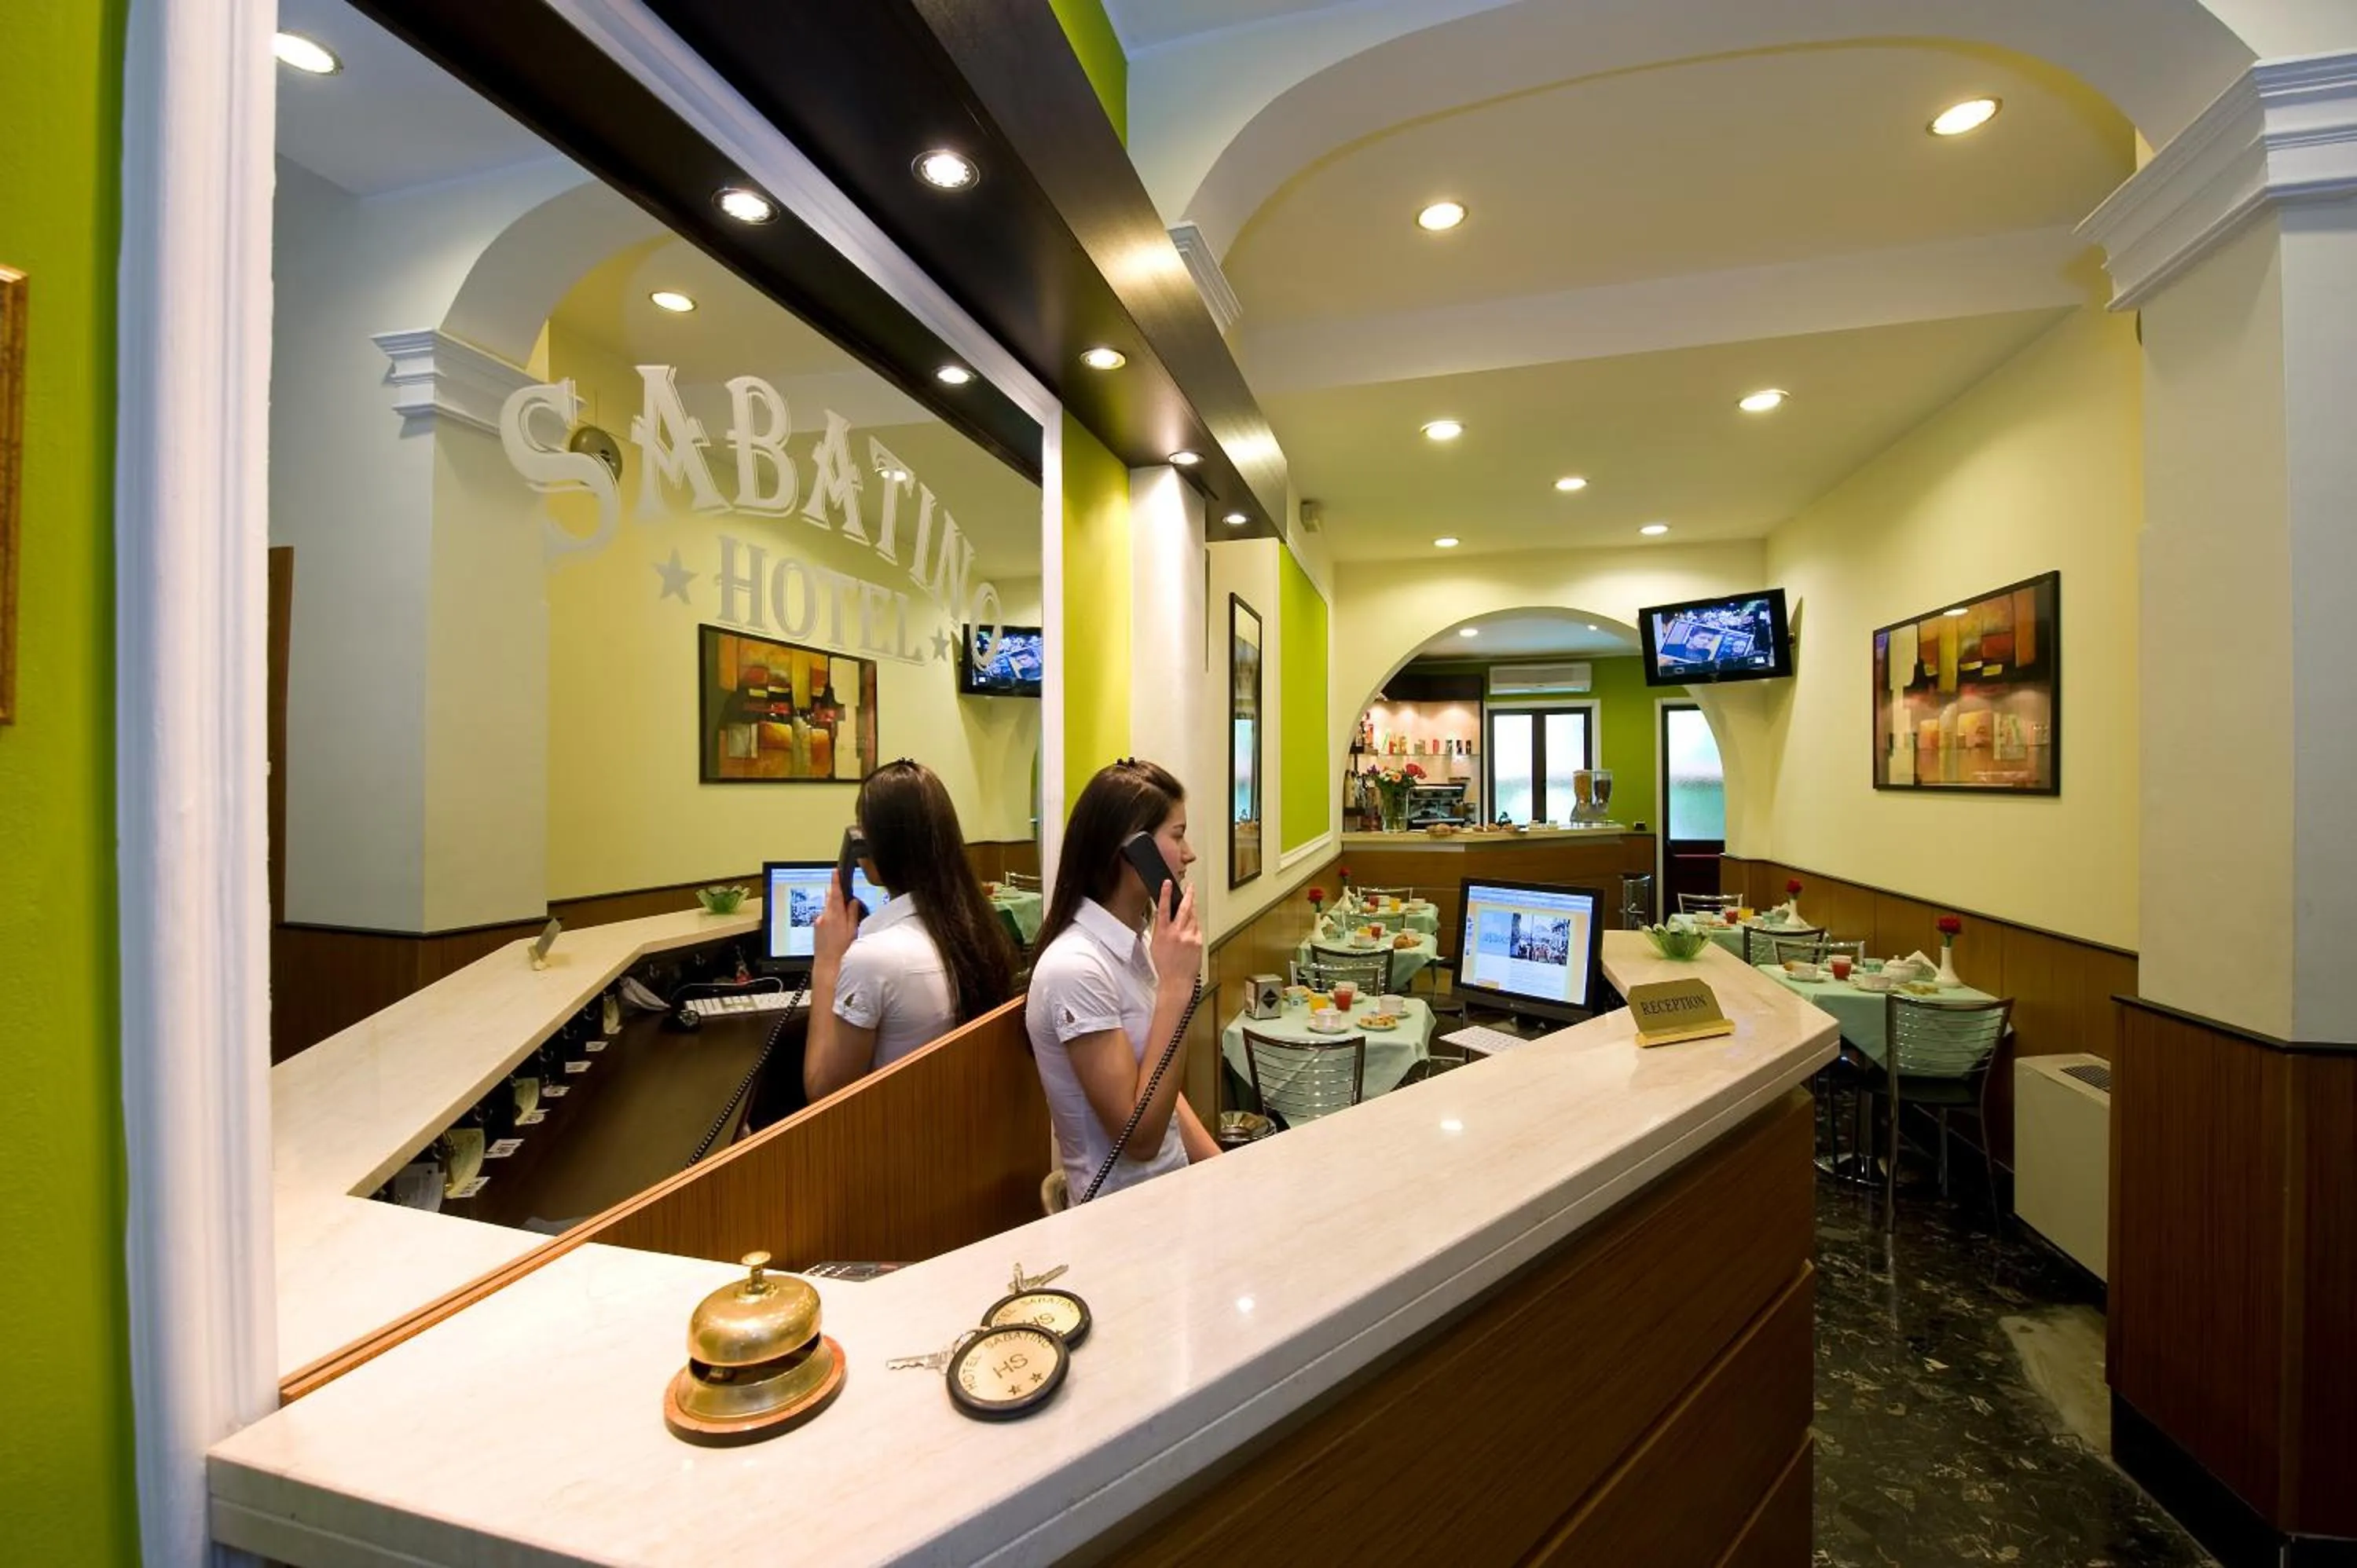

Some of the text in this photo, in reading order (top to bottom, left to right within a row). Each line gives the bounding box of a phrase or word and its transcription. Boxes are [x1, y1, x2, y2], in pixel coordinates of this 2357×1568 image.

[500, 365, 1002, 671] SABATINO
[714, 534, 926, 665] HOTEL
[1640, 995, 1708, 1016] RECEPTION
[962, 1332, 1051, 1391] HOTEL SABATINO
[992, 1353, 1028, 1379] HS
